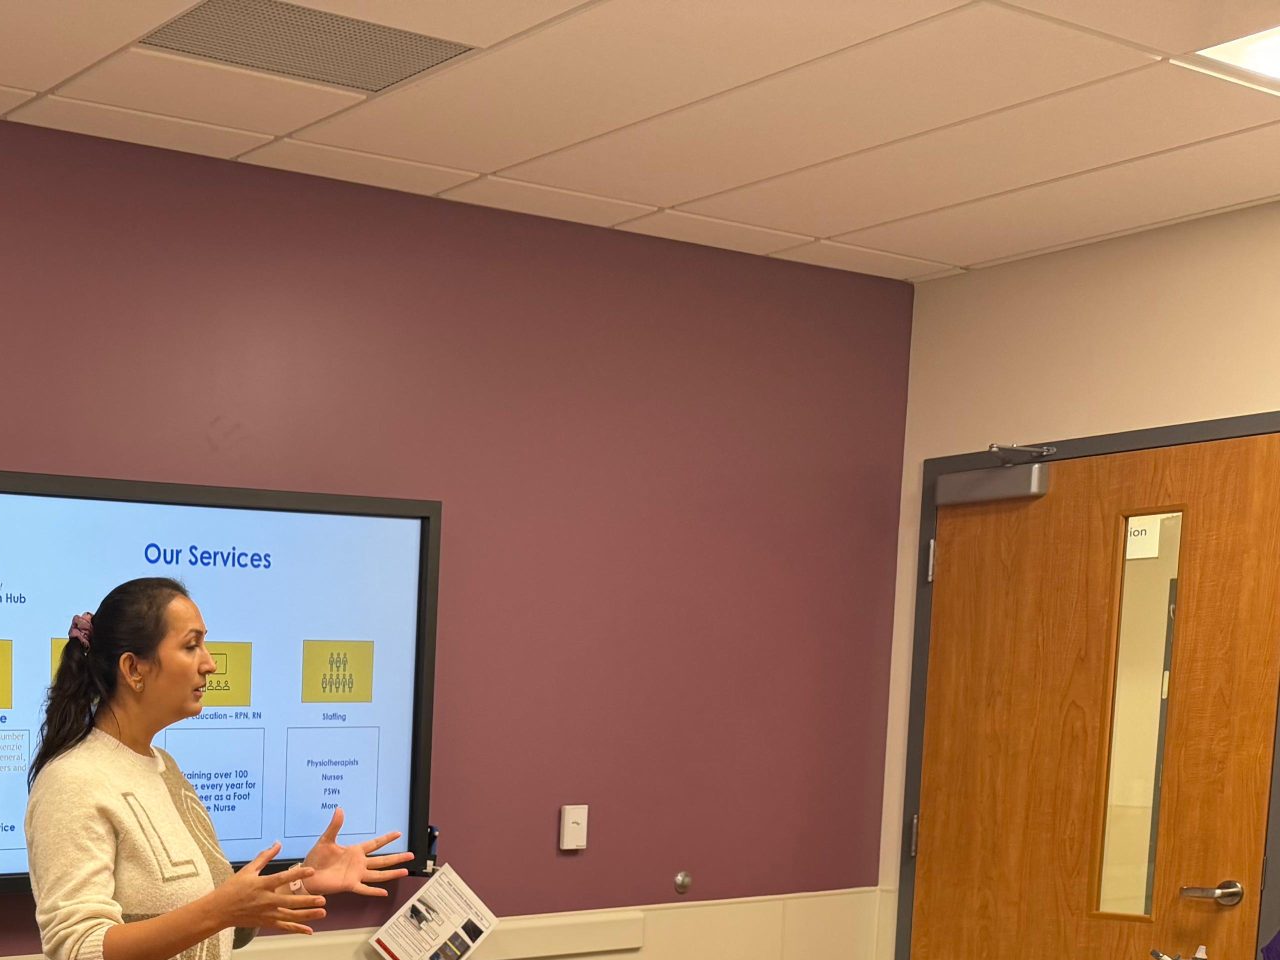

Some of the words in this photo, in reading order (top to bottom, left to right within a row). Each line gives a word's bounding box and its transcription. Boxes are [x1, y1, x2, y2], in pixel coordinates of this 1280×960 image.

[144, 542, 182, 565] Our
[188, 544, 271, 569] Services
[6, 593, 26, 604] Hub
[13, 764, 27, 772] and
[214, 771, 232, 779] over
[235, 770, 248, 779] 100
[322, 773, 343, 781] Nurses
[201, 783, 223, 791] every
[225, 782, 244, 791] year
[246, 781, 256, 789] for
[214, 793, 224, 801] as
[234, 792, 250, 801] Foot
[214, 804, 236, 812] Nurse
